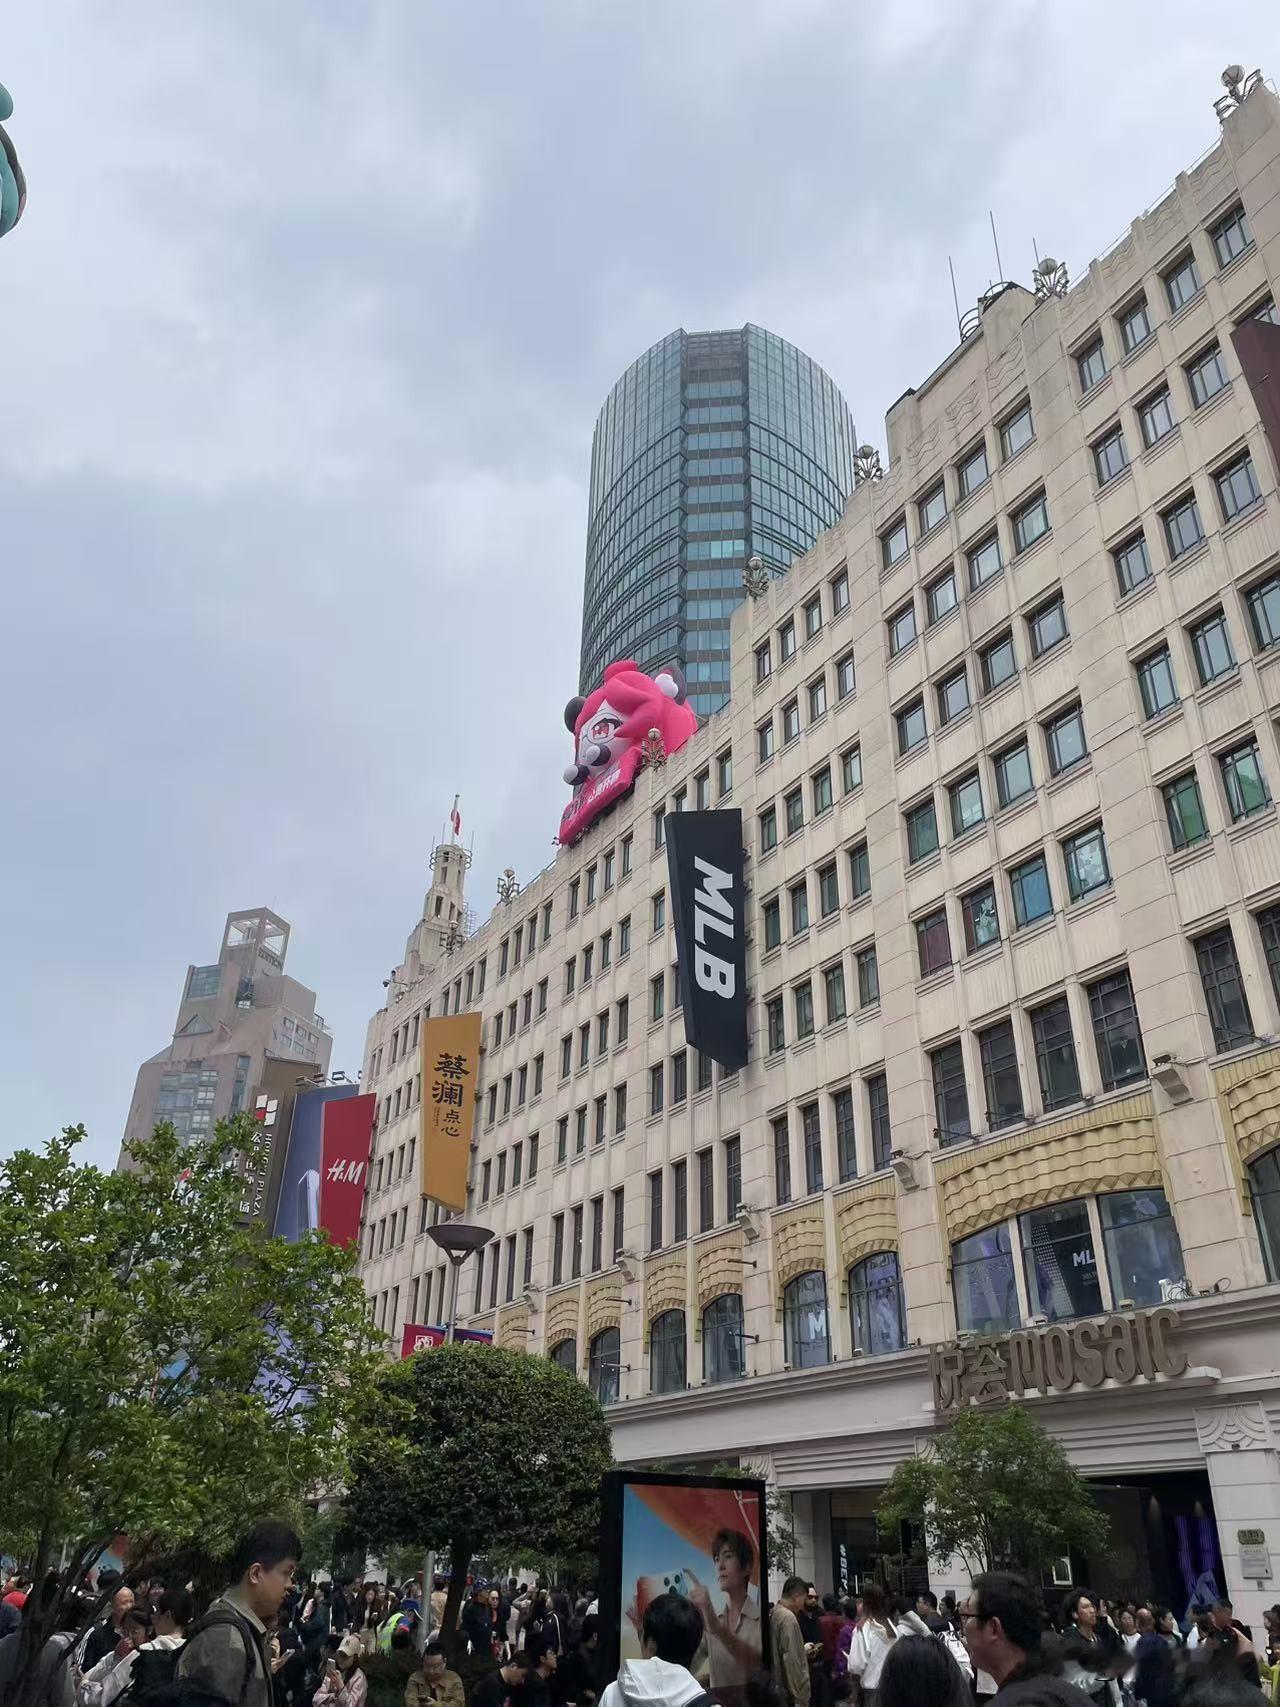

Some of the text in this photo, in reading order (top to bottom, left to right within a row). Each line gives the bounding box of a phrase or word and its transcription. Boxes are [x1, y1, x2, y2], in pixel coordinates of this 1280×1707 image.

[693, 855, 736, 1001] MLB
[326, 1158, 364, 1185] H&M
[252, 1180, 265, 1216] PLAZA
